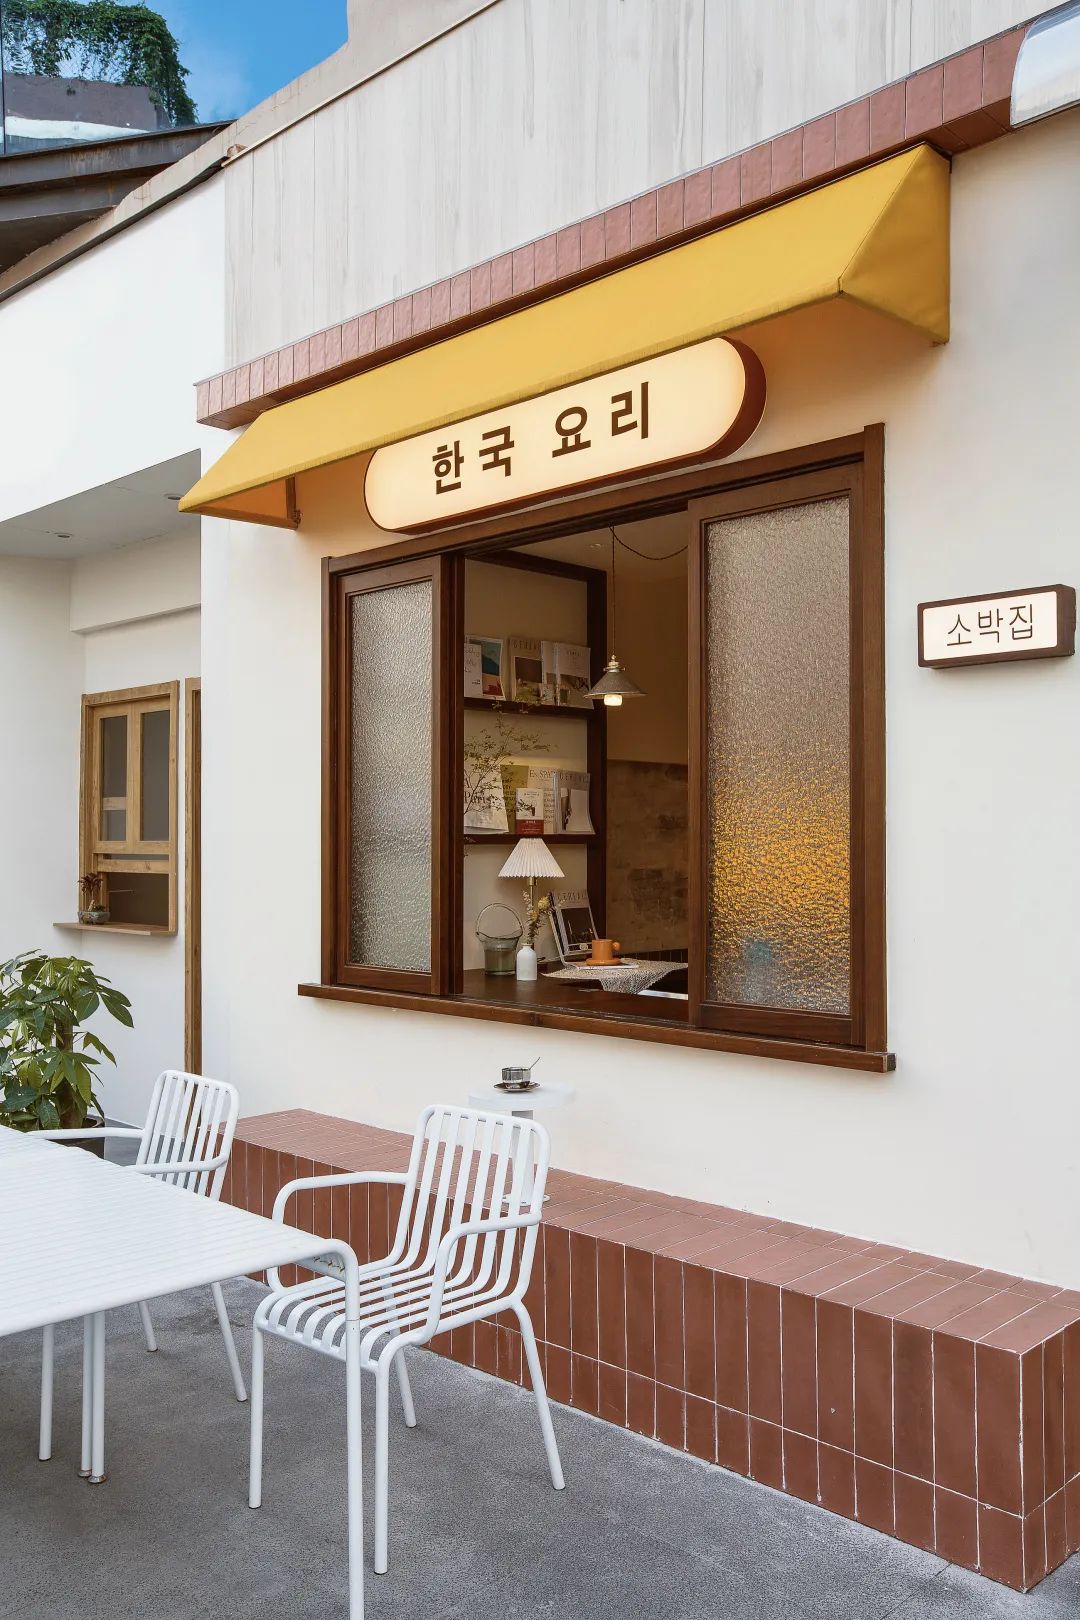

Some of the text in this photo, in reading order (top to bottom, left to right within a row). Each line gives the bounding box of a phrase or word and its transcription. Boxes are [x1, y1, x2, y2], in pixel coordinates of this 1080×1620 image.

[432, 381, 649, 495] 한국 요리
[946, 603, 1033, 646] 소박집
